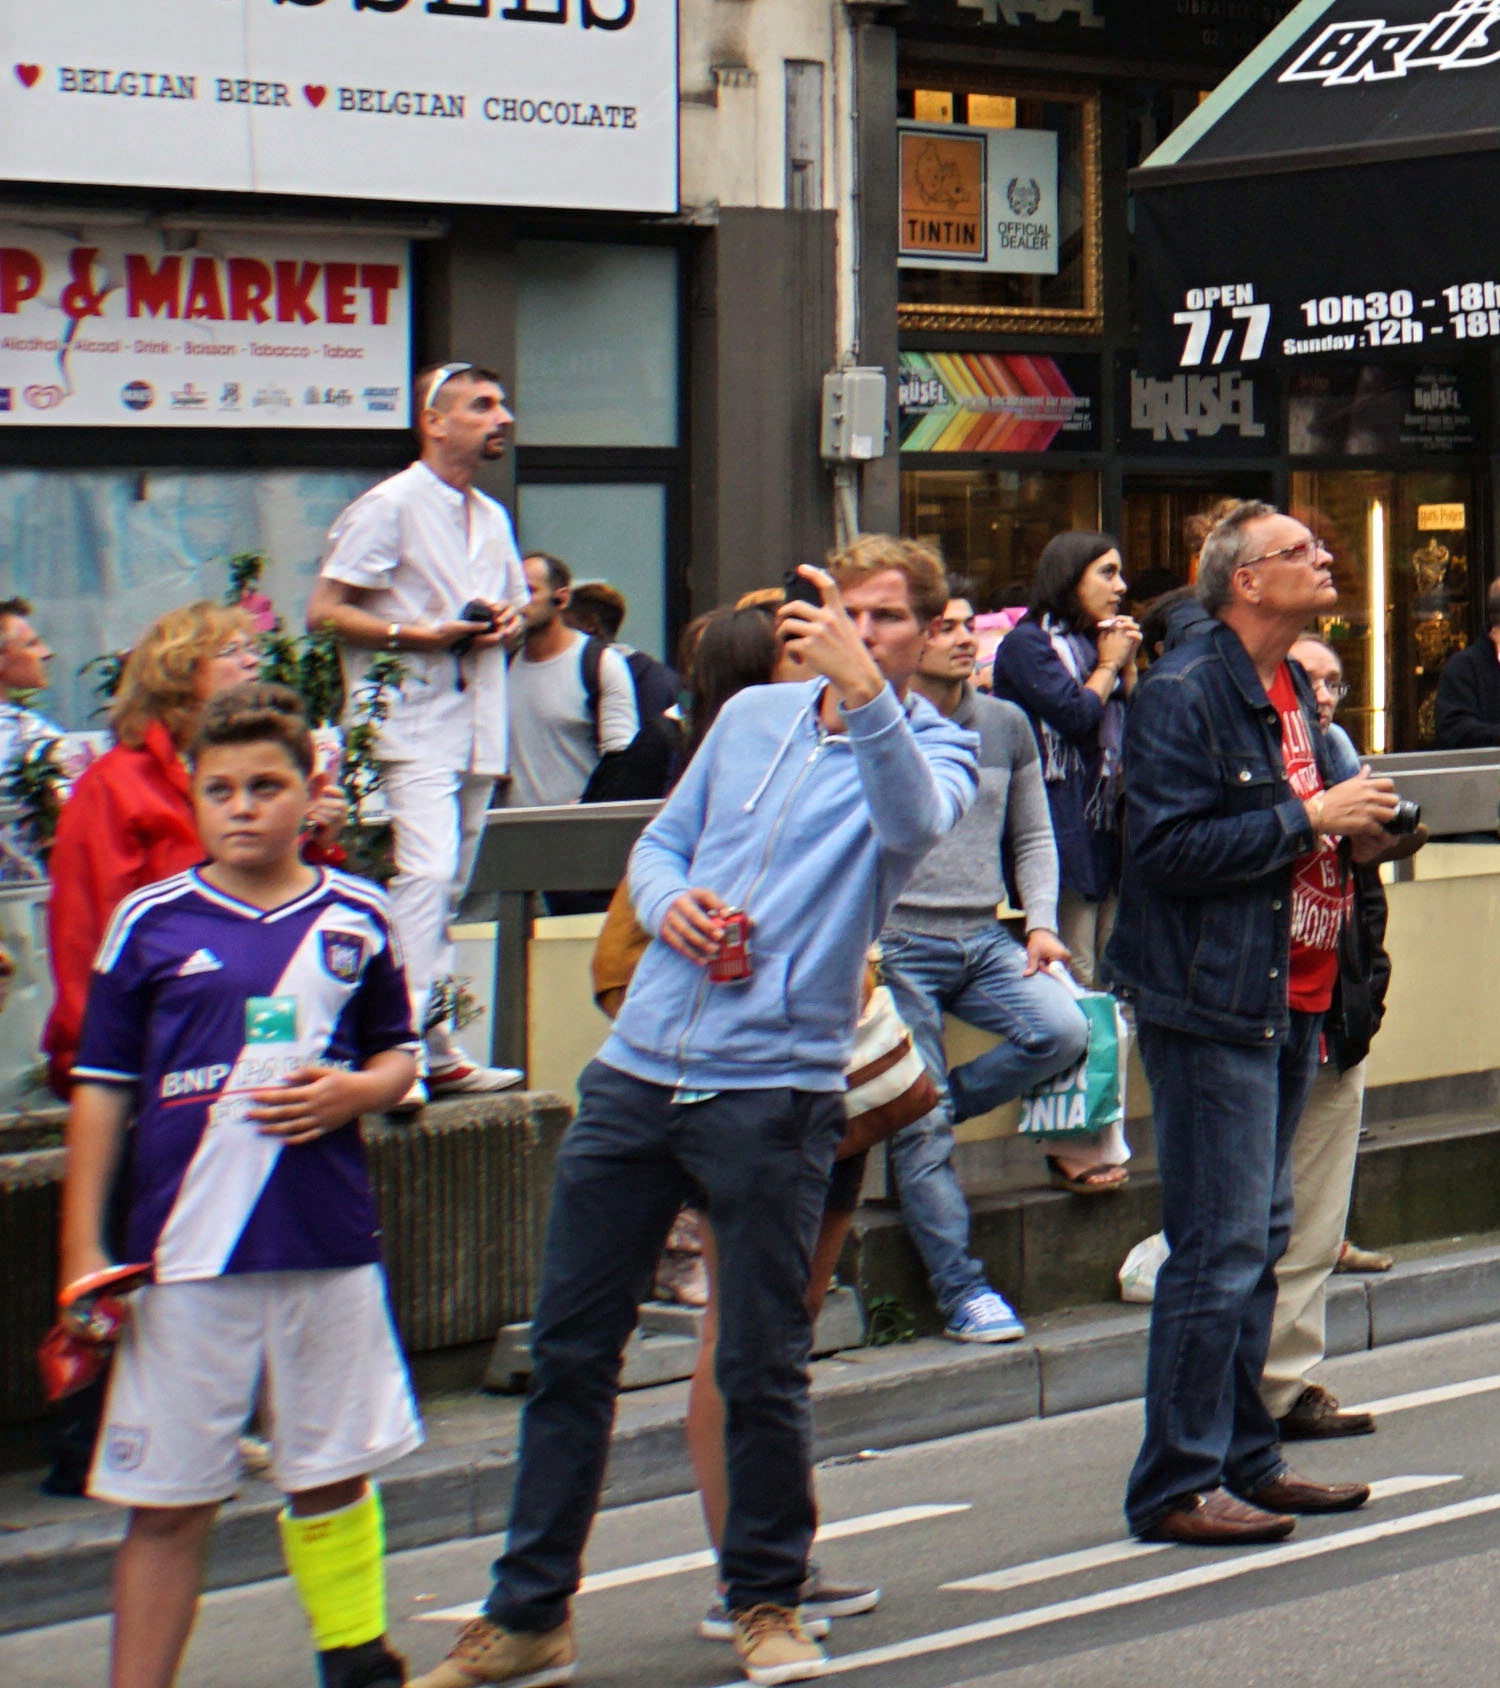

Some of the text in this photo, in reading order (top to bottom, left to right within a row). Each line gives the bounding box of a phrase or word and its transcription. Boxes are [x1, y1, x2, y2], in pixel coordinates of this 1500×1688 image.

[58, 67, 638, 129] BELGIAN BEER BELGIAN CHOCOLATE
[908, 219, 976, 244] TINTIN
[998, 222, 1051, 237] OFFICIAL
[1001, 235, 1049, 250] DEALER
[61, 247, 108, 319] &
[126, 253, 401, 326] MARKET
[1186, 283, 1254, 310] OPEN
[1301, 290, 1414, 327] 10h30
[1283, 333, 1355, 356] Sunday
[899, 375, 947, 406] RÜSEL
[160, 1064, 232, 1098] BNP
